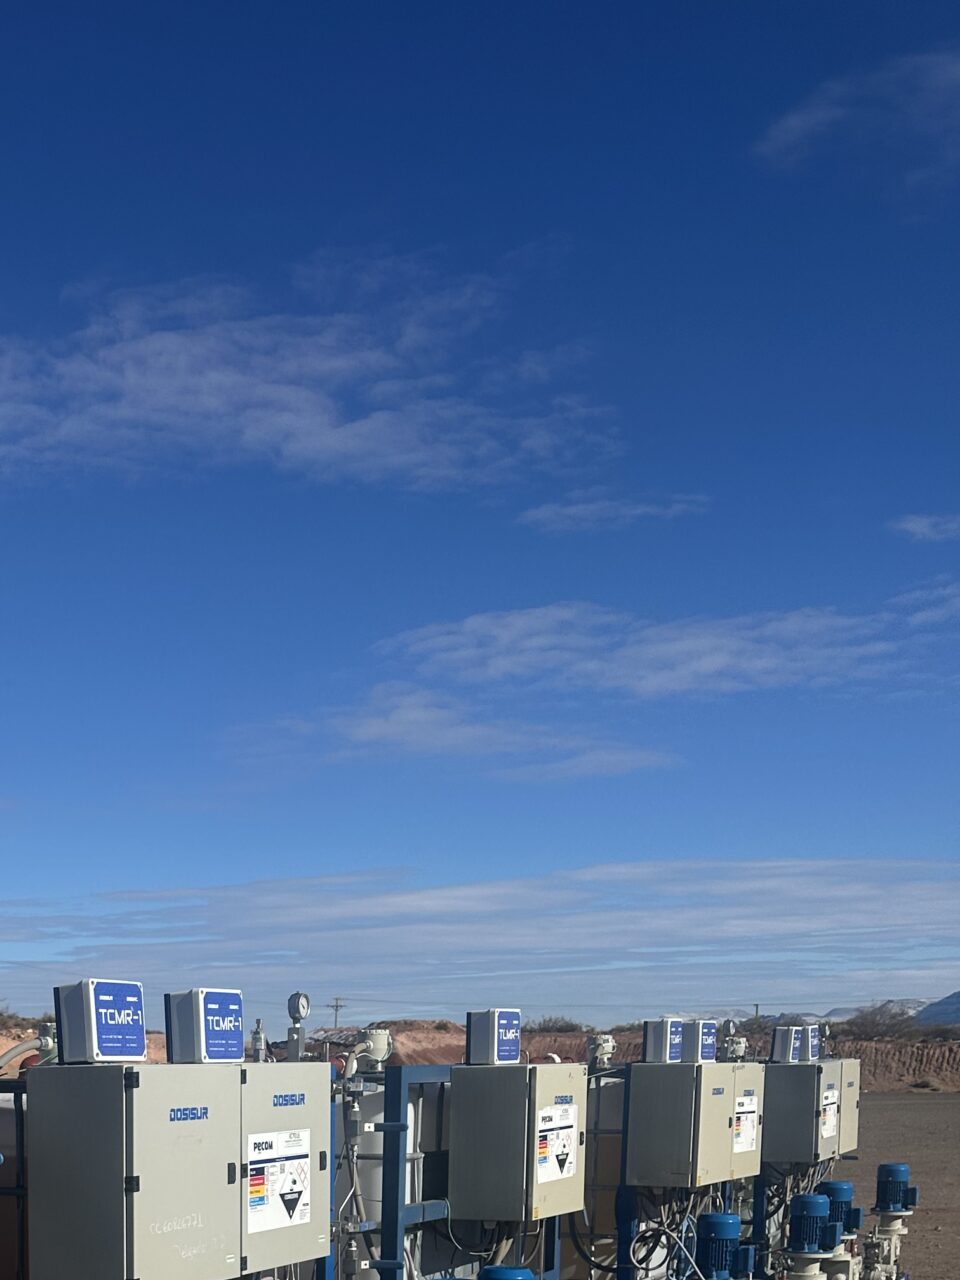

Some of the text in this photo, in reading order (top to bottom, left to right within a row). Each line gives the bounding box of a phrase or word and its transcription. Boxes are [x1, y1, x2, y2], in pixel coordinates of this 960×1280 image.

[98, 1008, 142, 1025] TCMR-1
[206, 1016, 242, 1031] TCMR-1
[272, 1093, 305, 1107] DOSISUR
[169, 1106, 209, 1121] DOSISUR
